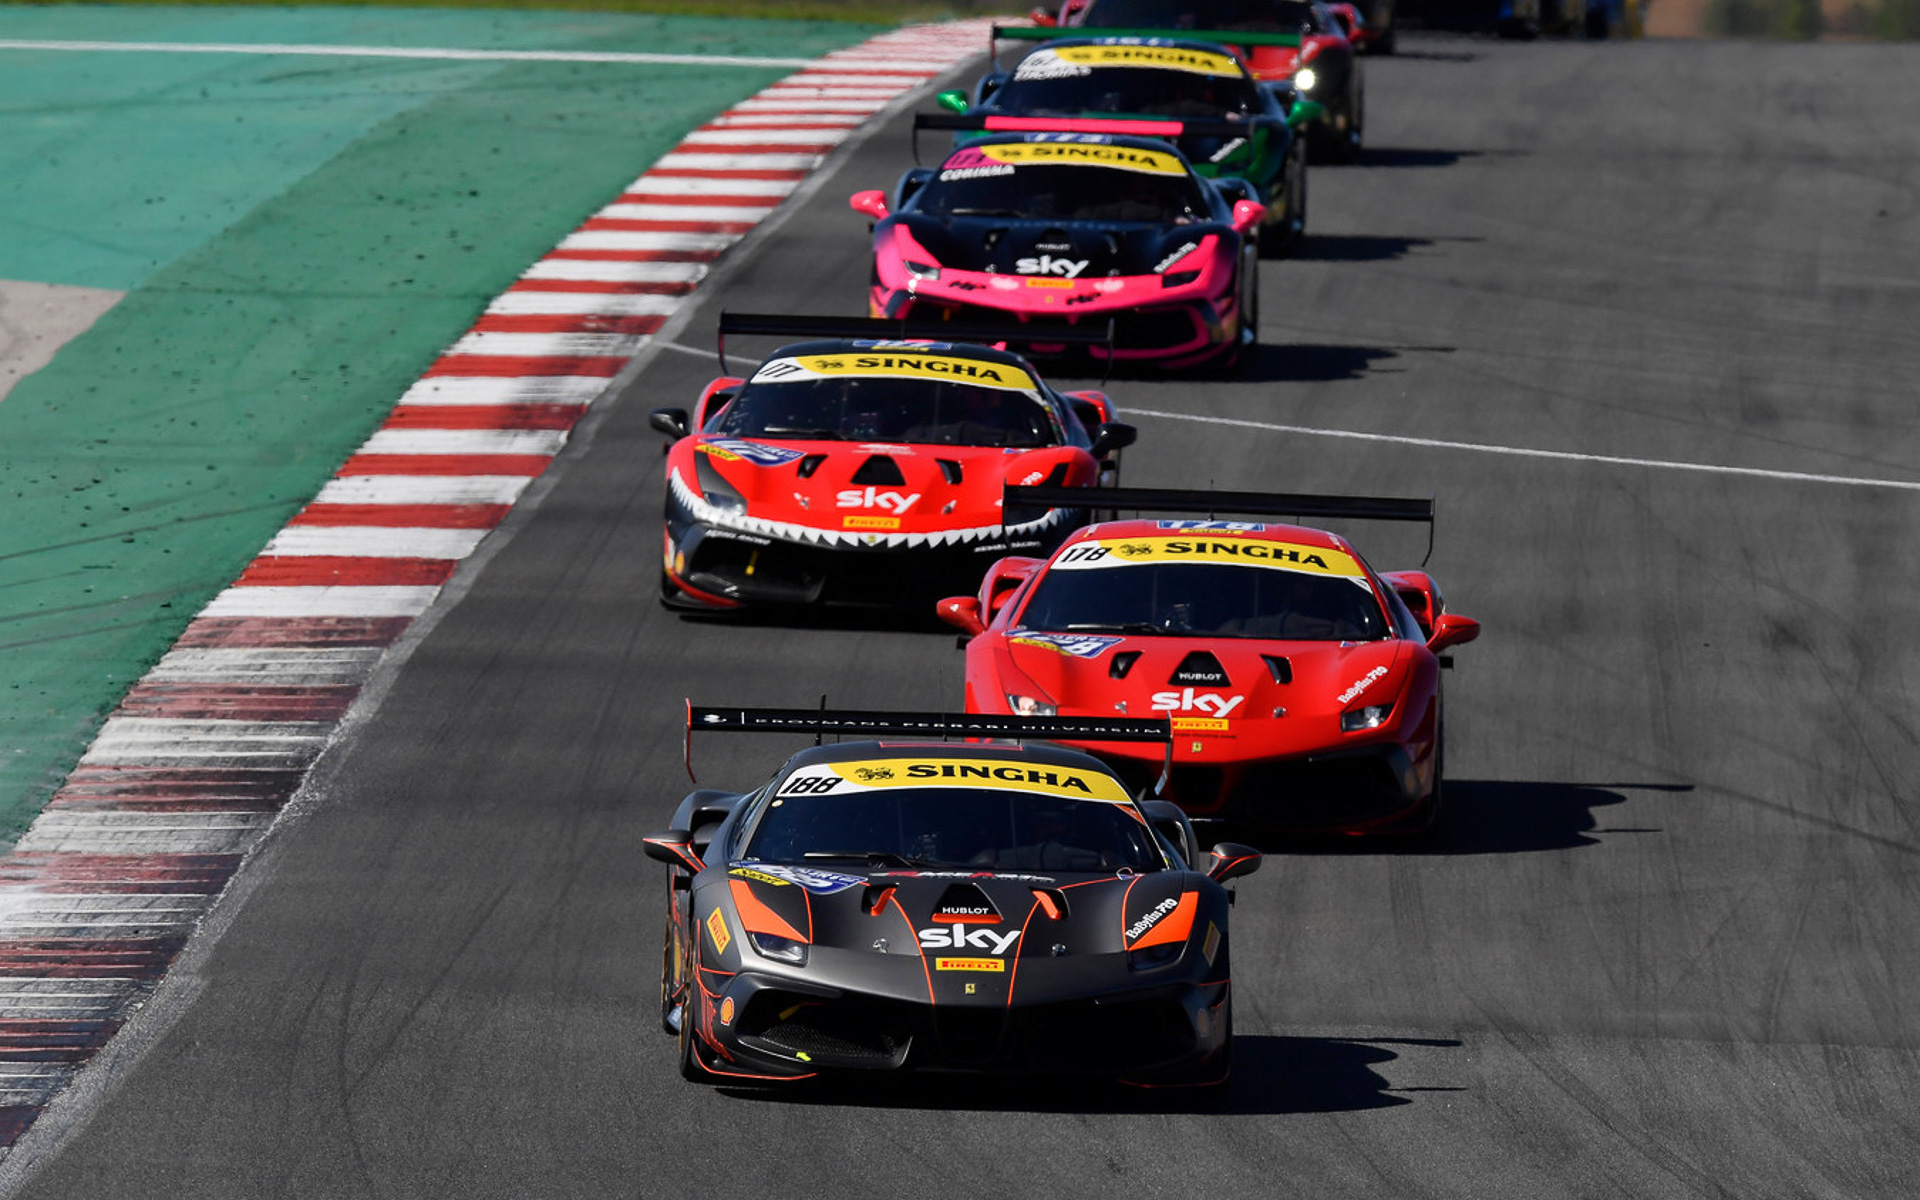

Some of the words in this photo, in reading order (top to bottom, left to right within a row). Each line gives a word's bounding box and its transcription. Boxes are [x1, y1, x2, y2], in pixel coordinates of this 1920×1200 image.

[1033, 148, 1159, 167] SINGHA
[1015, 255, 1090, 279] sky
[759, 362, 803, 378] 177
[855, 357, 1003, 382] SINGHA
[836, 486, 921, 515] sky
[1061, 546, 1113, 563] 178
[1164, 541, 1330, 569] SINGHA
[1178, 672, 1223, 681] HUBLOT
[1151, 687, 1245, 718] sky
[903, 721, 1008, 730] FERRARI
[780, 776, 844, 795] 188
[906, 764, 1093, 793] SINGHA
[942, 906, 990, 915] HUBLOT
[918, 923, 1022, 954] sky
